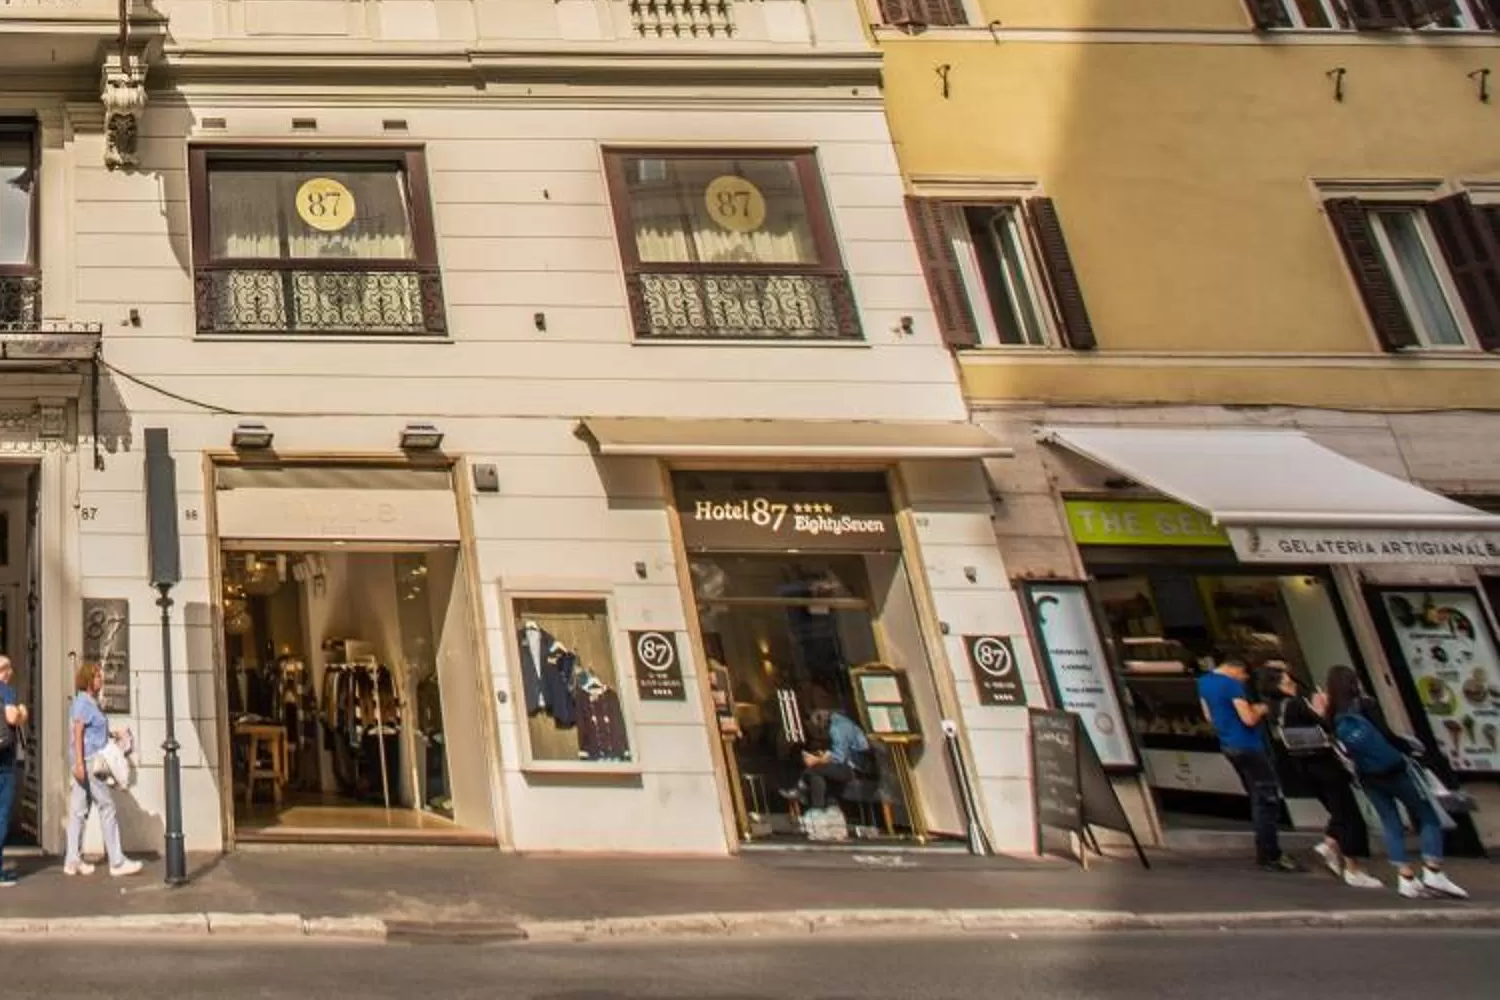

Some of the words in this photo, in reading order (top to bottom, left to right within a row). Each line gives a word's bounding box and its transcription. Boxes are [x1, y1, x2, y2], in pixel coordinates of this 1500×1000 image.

[308, 191, 340, 217] 87
[716, 191, 751, 217] 87
[81, 507, 98, 521] 87
[695, 501, 750, 521] Hotel
[751, 498, 789, 532] 87
[794, 515, 885, 535] EightySeven
[1078, 508, 1142, 537] THE
[1278, 539, 1375, 556] GELATERIA
[643, 640, 667, 663] 87
[981, 645, 1005, 669] 87
